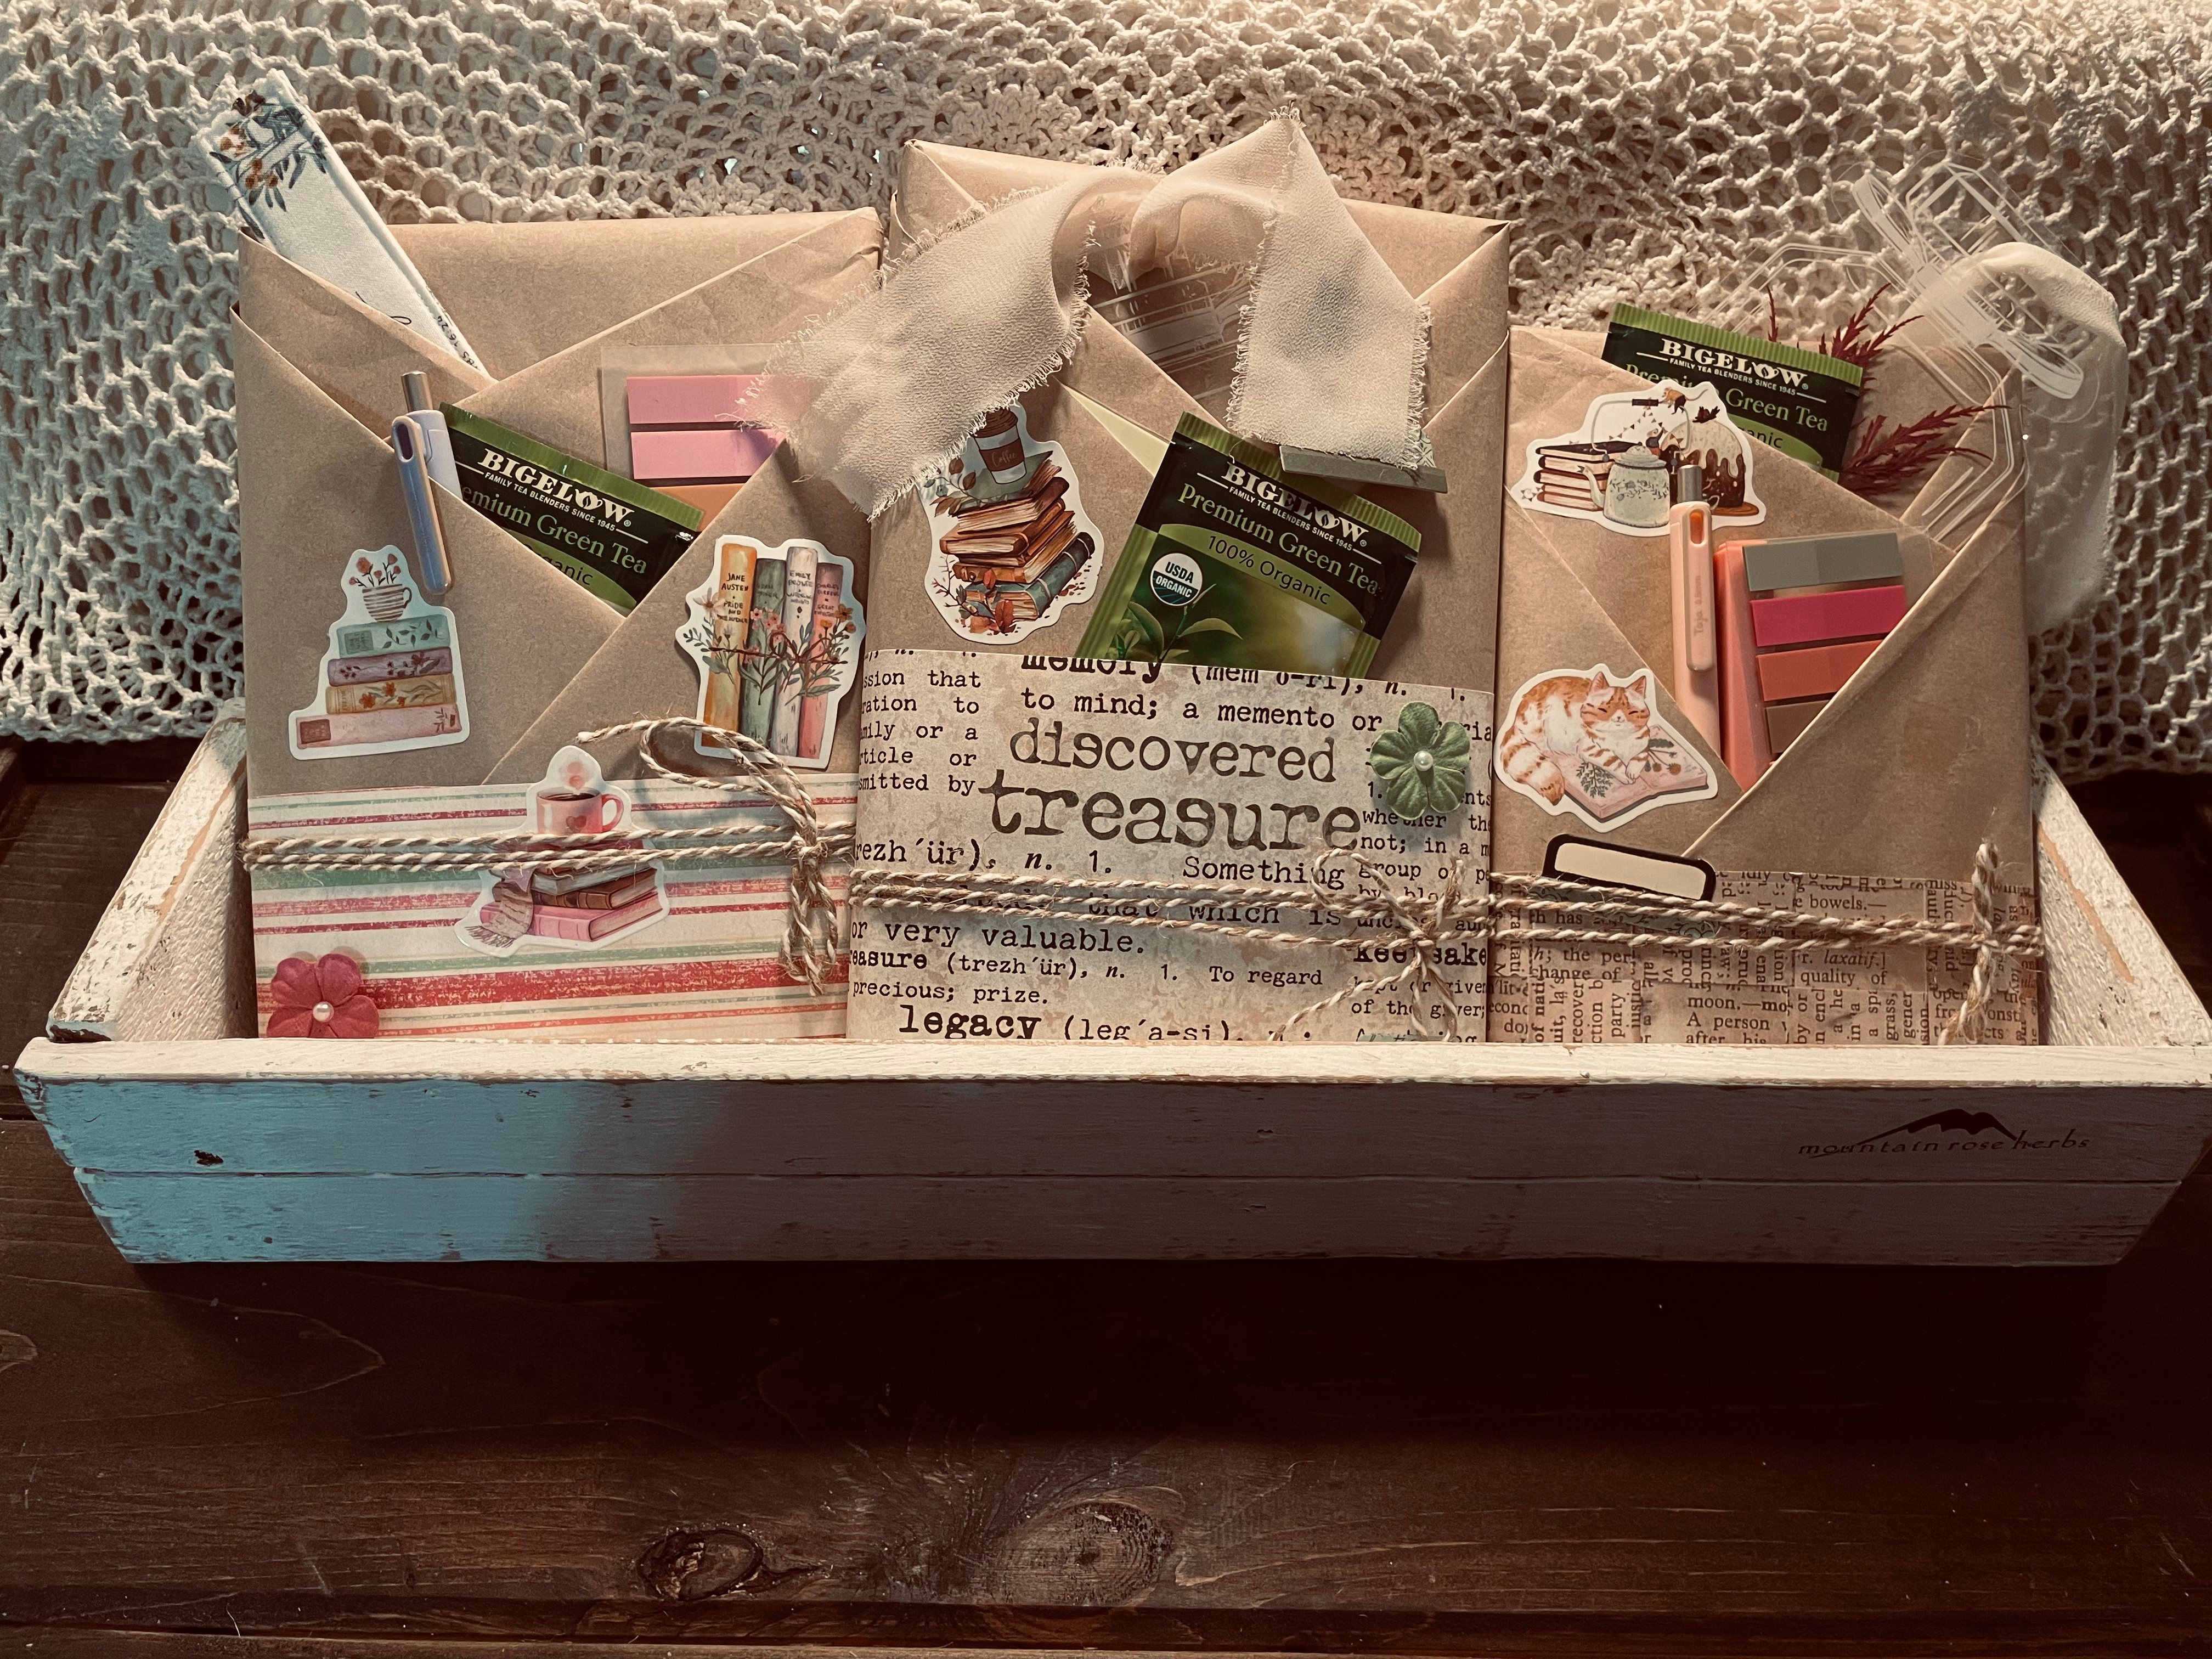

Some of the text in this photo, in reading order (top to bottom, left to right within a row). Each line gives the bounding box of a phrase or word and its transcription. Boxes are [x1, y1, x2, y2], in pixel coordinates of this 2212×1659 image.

[1669, 358, 1796, 396] FAMILY TEA BLENDERS SINCE 1945
[1725, 387, 1829, 432] Green Tea
[484, 471, 616, 532] FAMILY TEA BLENDERS SINCE 1945
[1228, 486, 1353, 551] FAMILY TEA BLENDERS SINCE 1945
[537, 514, 605, 558] Green
[610, 541, 647, 574] Tea
[1177, 483, 1379, 595] Premium Green Tea
[726, 572, 746, 582] JANE
[1165, 561, 1194, 584] USDA
[1208, 535, 1331, 605] 100% Organic
[721, 583, 749, 591] AUSTEN
[1155, 575, 1192, 598] ORGANIC
[723, 600, 743, 609] PRIDE
[927, 669, 981, 688] that
[953, 696, 979, 714] to
[1021, 687, 1055, 710] to
[1074, 693, 1158, 720] mind;
[1182, 702, 1199, 719] a
[1217, 704, 1335, 729] memento
[1352, 715, 1382, 731] or
[916, 725, 943, 738] or
[965, 727, 978, 741] a
[949, 752, 977, 767] or
[1009, 716, 1336, 783] discovered
[948, 775, 975, 797] by
[978, 769, 1361, 851] treasure
[1361, 834, 1406, 854] not;
[1424, 837, 1447, 853] in
[1459, 842, 1470, 854] a
[1024, 852, 1053, 871] n.
[1088, 849, 1112, 873] 1.
[1183, 855, 1345, 891] Something
[1358, 862, 1421, 881] group
[1556, 911, 1583, 924] has
[851, 920, 1144, 953] or very valuable.
[1564, 947, 1590, 961] the
[1105, 966, 1126, 979] n.
[1160, 963, 1178, 981] 1.
[1209, 966, 1234, 983] To
[1247, 969, 1323, 988] regard
[1601, 967, 1621, 980] of
[1801, 968, 1888, 987] quality of
[853, 980, 1048, 1005] precious; prize.
[1351, 999, 1374, 1014] of
[1611, 993, 1626, 1037] party
[1886, 993, 1899, 1041] grass,
[899, 1005, 1042, 1039] legacy
[1686, 1012, 1770, 1031] A person
[1793, 994, 1810, 1044] by or
[1833, 1024, 1843, 1033] a
[1847, 1003, 1861, 1042] in a
[1686, 1030, 1725, 1043] after
[1869, 1028, 1878, 1037] a
[1798, 1128, 2091, 1159] mountain rose herbs
